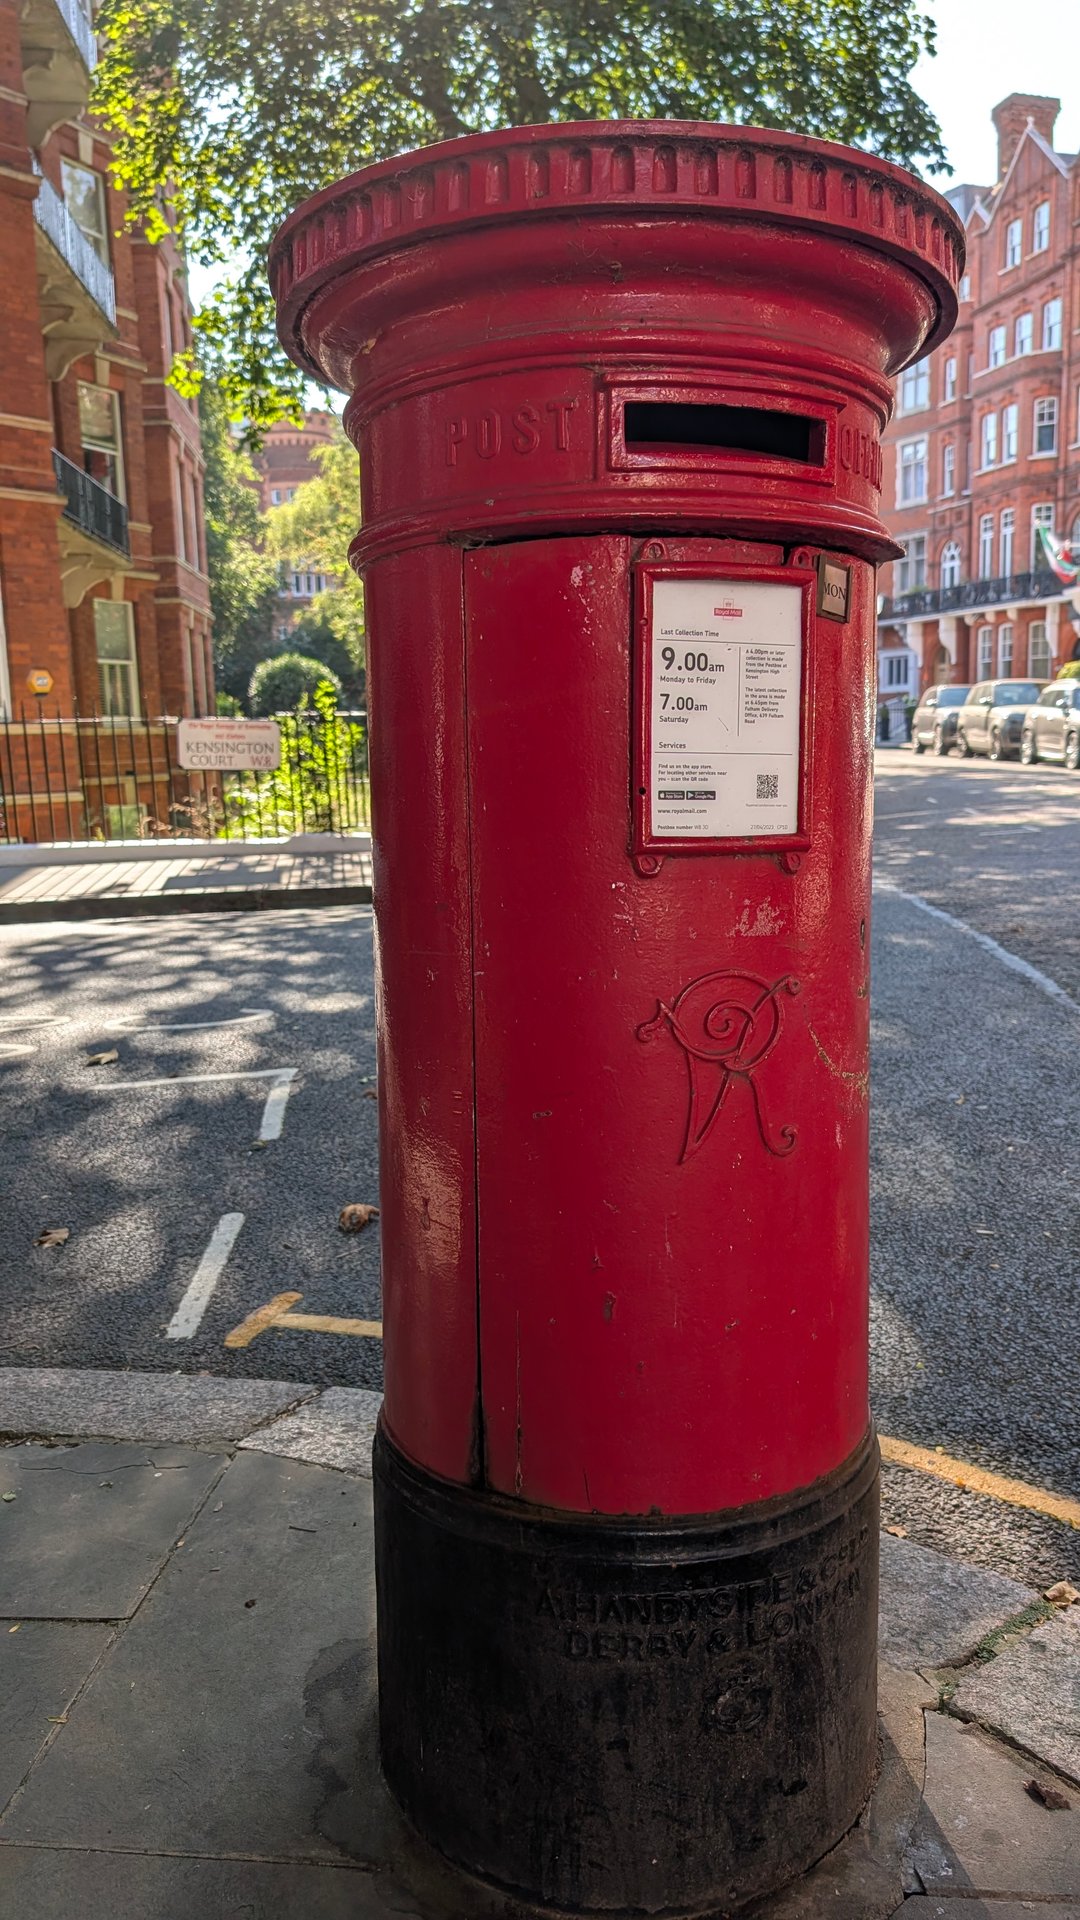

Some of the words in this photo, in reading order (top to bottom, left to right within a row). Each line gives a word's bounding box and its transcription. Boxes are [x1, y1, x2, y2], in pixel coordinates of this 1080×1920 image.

[446, 399, 575, 466] POST
[824, 582, 846, 600] MON
[662, 647, 724, 672] 9.00am
[660, 675, 685, 684] Monday
[696, 676, 716, 684] Friday
[660, 693, 708, 711] 7.00am
[659, 715, 688, 724] Saturday
[186, 742, 274, 754] KENSINGTON
[567, 1628, 698, 1659] DERBY
